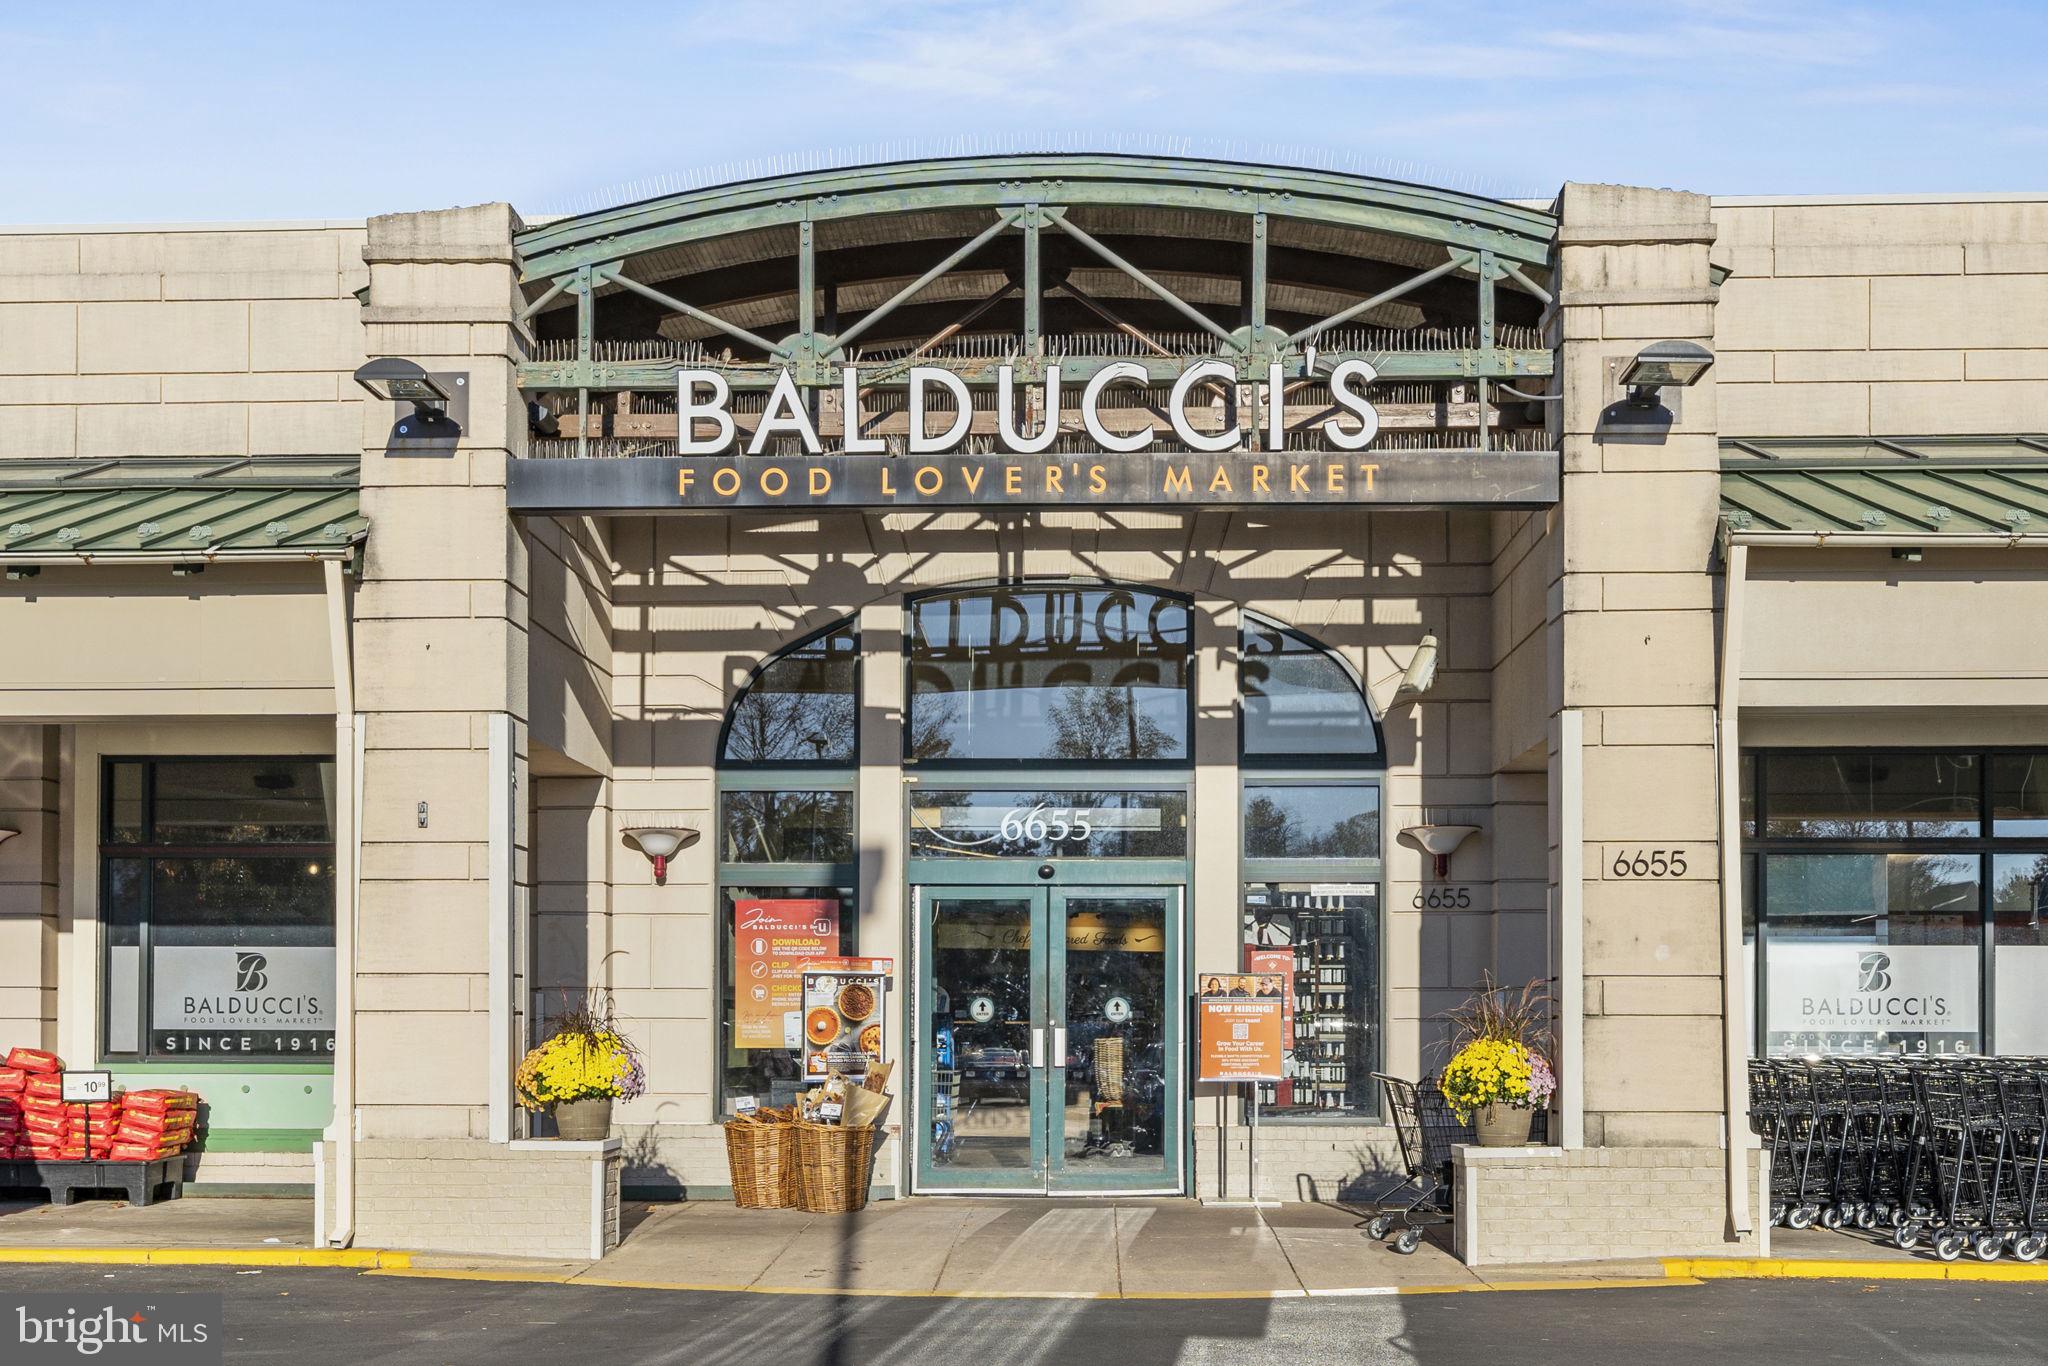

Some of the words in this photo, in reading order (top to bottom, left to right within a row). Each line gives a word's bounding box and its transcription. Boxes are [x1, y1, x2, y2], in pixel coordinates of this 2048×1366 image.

[676, 347, 1380, 456] BALDUCCI'S
[678, 466, 832, 496] FOOD
[882, 462, 1108, 495] LOVER'S
[1163, 463, 1380, 494] MARKET
[1000, 808, 1093, 841] 6655
[1612, 850, 1688, 877] 6655
[1412, 887, 1471, 909] 6655
[740, 908, 782, 929] Join
[772, 938, 821, 946] DOWNLOAD
[771, 961, 789, 969] CLIP
[771, 984, 802, 992] CHECKO
[184, 995, 318, 1015] BALDUCCI'S
[1208, 1005, 1232, 1013] NOW
[1234, 1005, 1273, 1013] HIRING!
[1802, 995, 1946, 1016] BALDUCCI'S
[222, 1016, 267, 1024] LOVER'S
[1843, 1018, 1891, 1026] LOVER'S
[165, 1036, 252, 1051] SINCE
[274, 1036, 336, 1051] 1916
[1783, 1039, 1874, 1053] SINCE
[1899, 1039, 1966, 1054] 1916
